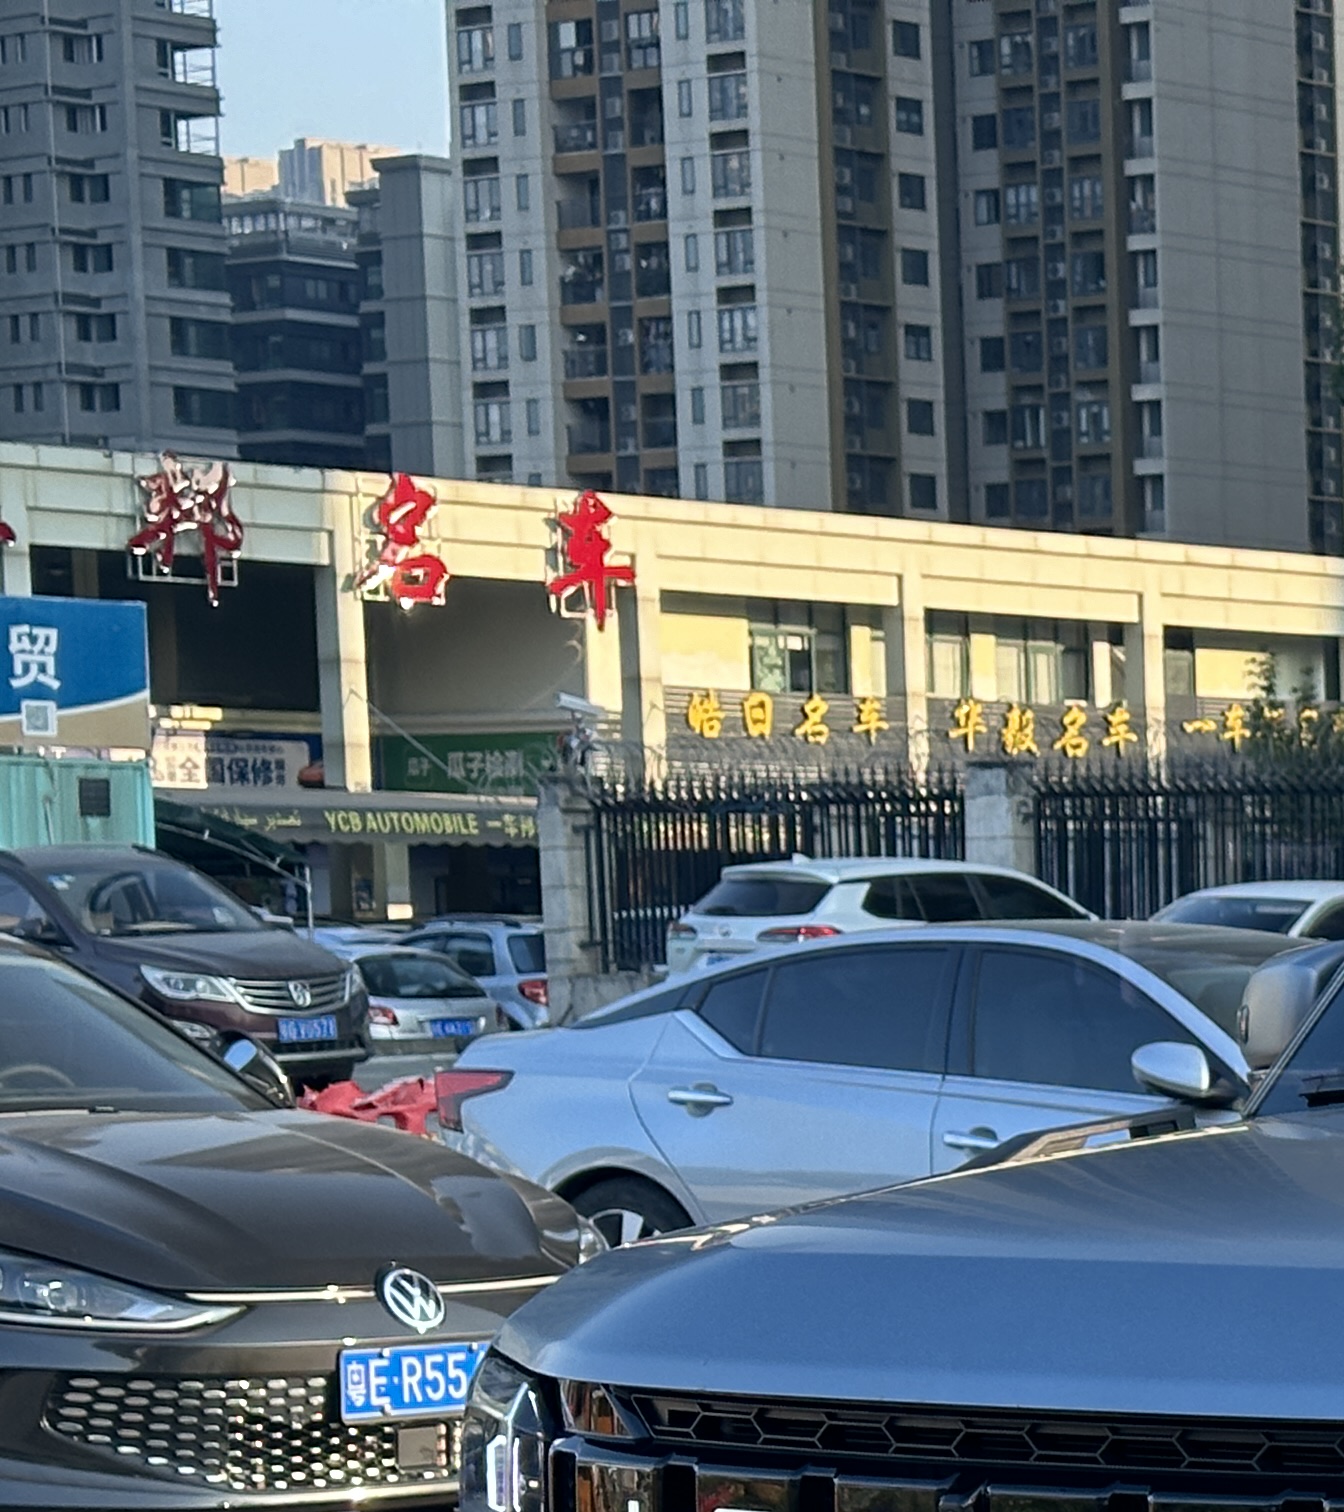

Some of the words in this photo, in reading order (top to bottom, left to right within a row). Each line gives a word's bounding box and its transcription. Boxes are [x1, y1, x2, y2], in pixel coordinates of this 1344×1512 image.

[8, 624, 61, 690] 贸
[324, 810, 361, 834] YCB
[365, 811, 480, 836] AUTOMOBILE
